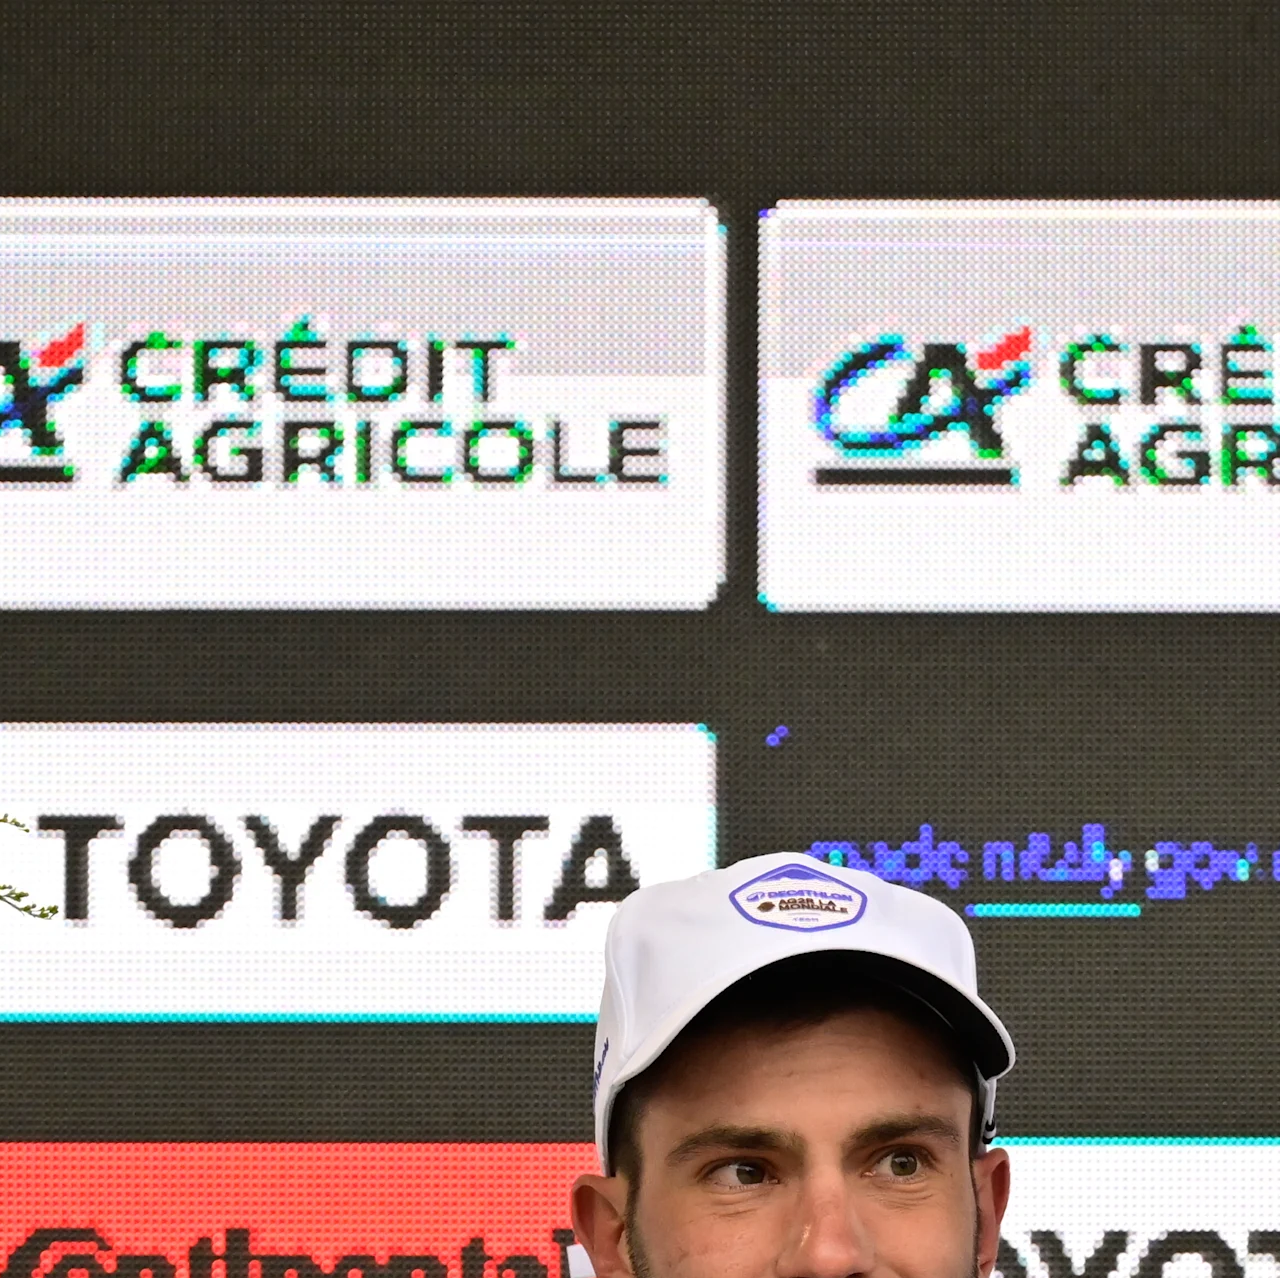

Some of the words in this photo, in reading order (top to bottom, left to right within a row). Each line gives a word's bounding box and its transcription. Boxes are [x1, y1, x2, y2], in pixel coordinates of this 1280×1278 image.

[119, 315, 516, 402] CRÉDIT
[120, 416, 669, 485] AGRICOLE
[37, 813, 642, 929] TOYOTA
[767, 889, 853, 902] DECATHLON
